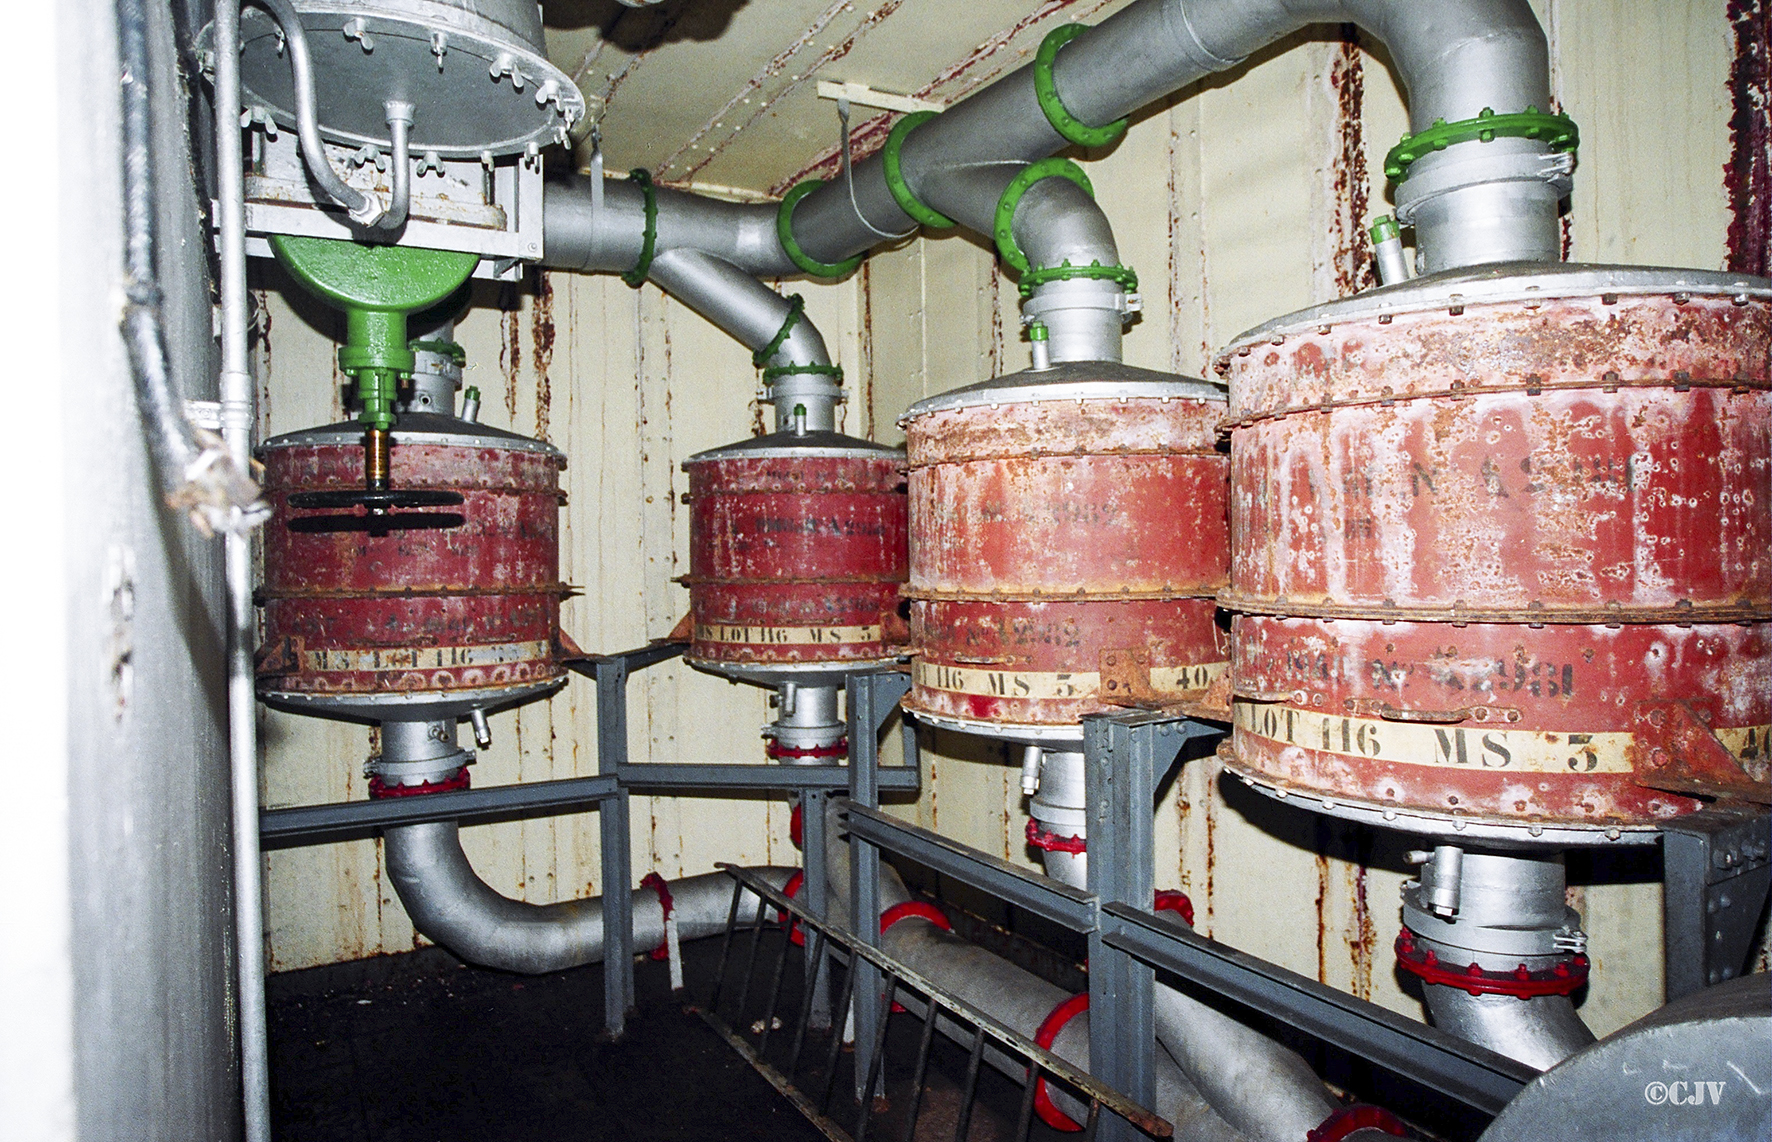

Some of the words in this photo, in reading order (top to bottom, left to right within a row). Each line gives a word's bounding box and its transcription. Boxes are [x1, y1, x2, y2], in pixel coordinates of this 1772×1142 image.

[720, 625, 753, 643] LOT
[760, 627, 788, 643] 116
[373, 650, 422, 668] LT
[937, 665, 965, 690] 116
[1176, 666, 1208, 690] 40
[1250, 703, 1300, 742] LOT
[1321, 717, 1381, 757] 116
